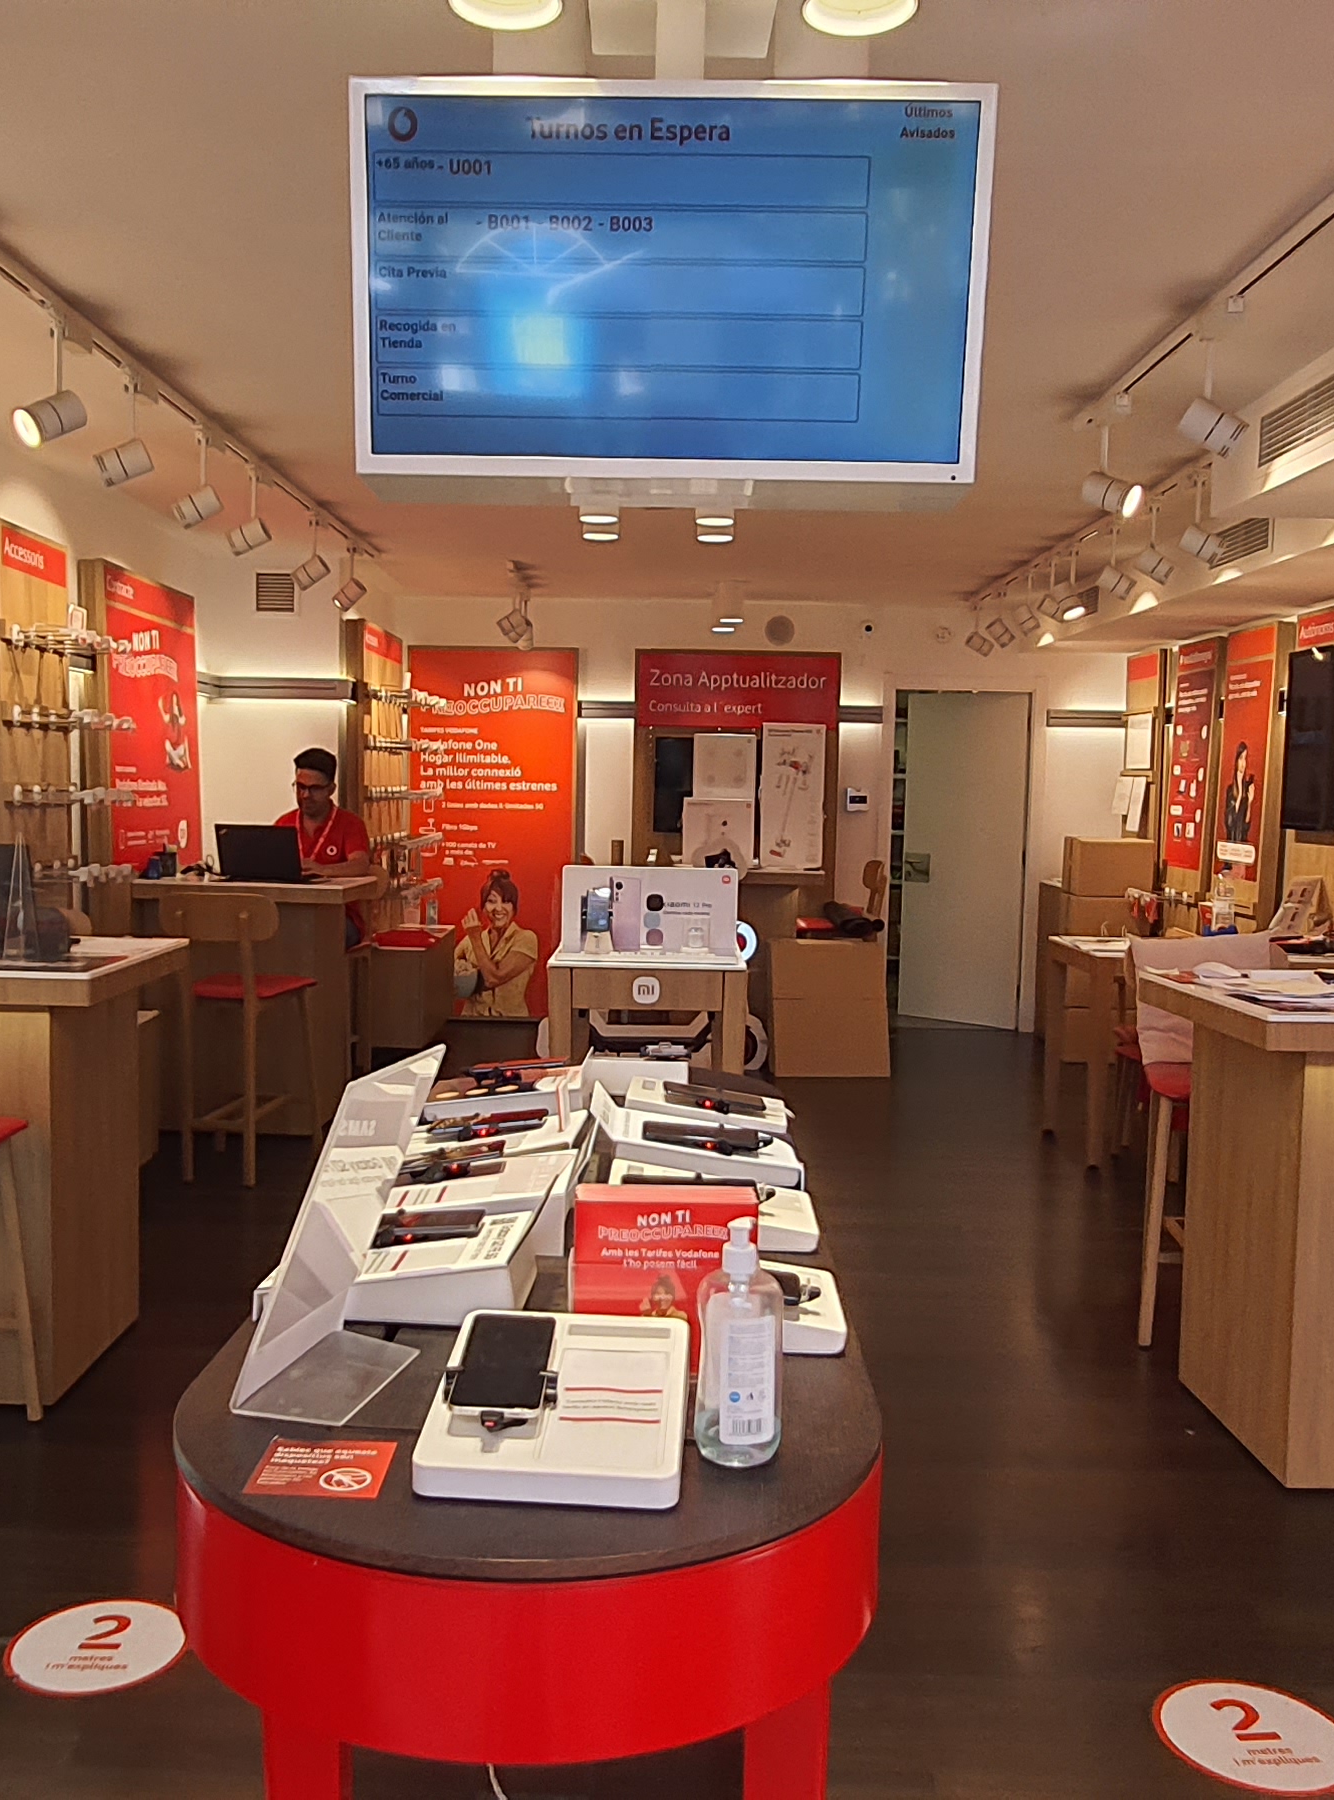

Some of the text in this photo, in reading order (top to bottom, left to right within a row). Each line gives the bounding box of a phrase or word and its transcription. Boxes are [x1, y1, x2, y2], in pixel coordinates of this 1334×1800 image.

[904, 102, 953, 118] Últimos
[526, 116, 731, 147] Turnos en Espera
[899, 126, 956, 139] Avisados
[376, 156, 492, 176] +65 años U001
[377, 210, 654, 233] Atención al B001 B002 B003
[377, 228, 423, 242] Cliente
[378, 265, 447, 279] Cita Previa
[379, 319, 456, 333] Recogida en
[379, 336, 423, 349] Tienda
[379, 371, 417, 384] Turno
[380, 389, 444, 402] Comercial
[4, 536, 45, 570] Accessoris
[132, 629, 160, 651] NON TI
[463, 676, 523, 697] NON TI
[649, 668, 827, 691] Zona Apptualitzador
[648, 699, 702, 714] Consulta
[704, 704, 711, 714] a
[474, 739, 498, 750] One
[420, 752, 454, 766] Hogar
[419, 765, 522, 777] La millor connexió
[419, 778, 558, 791] amb les últimes estrenes
[636, 1209, 691, 1227] NON TI
[600, 1247, 720, 1259] Amb les Tarifes Vodafone
[77, 1614, 132, 1651] 2
[68, 1654, 114, 1663] metres
[1209, 1698, 1283, 1742] 2
[1245, 1747, 1294, 1757] metres
